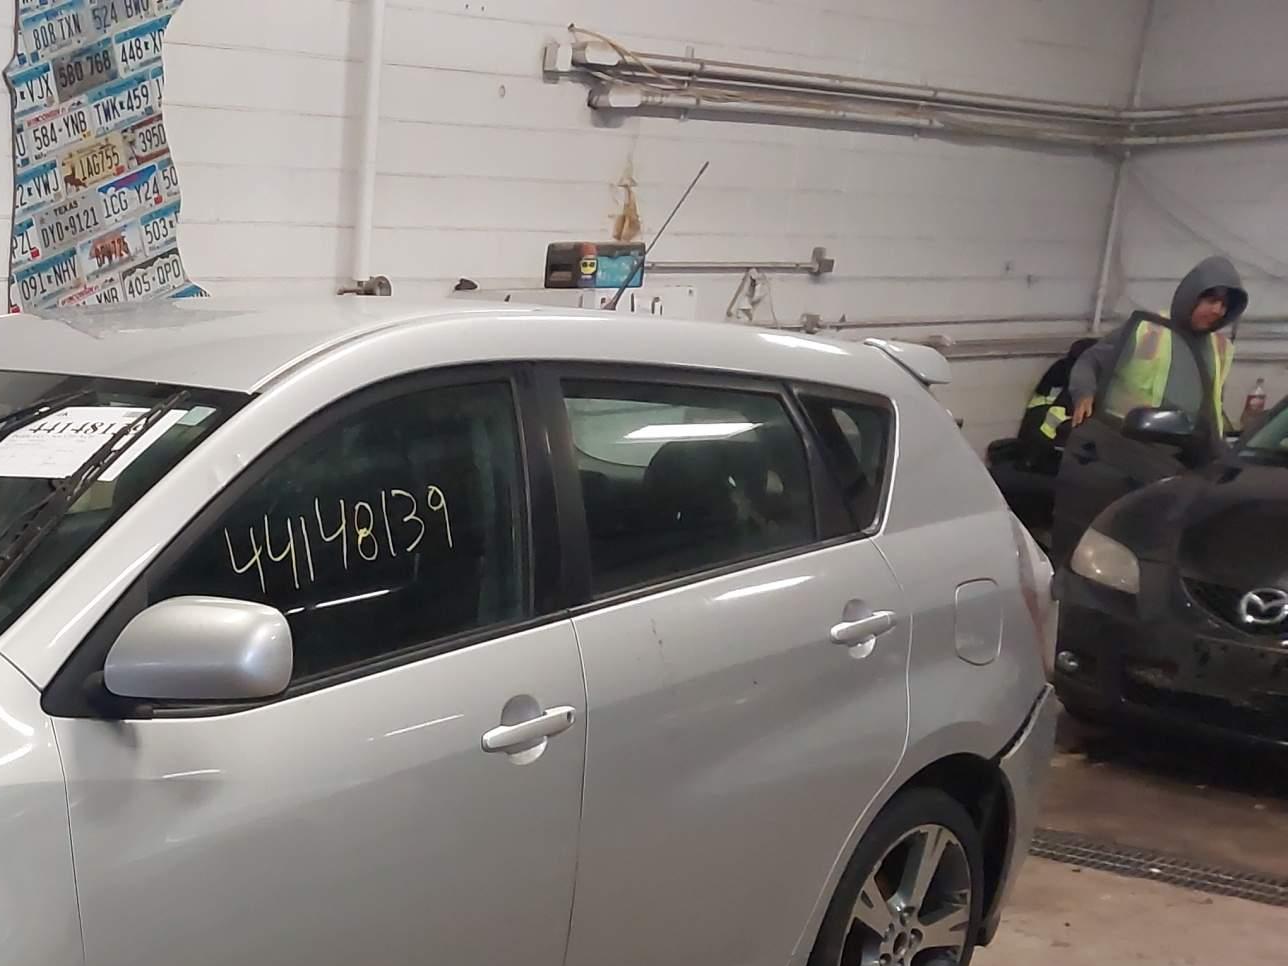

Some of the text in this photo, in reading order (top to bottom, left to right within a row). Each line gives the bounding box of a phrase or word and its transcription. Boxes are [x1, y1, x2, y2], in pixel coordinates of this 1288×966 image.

[33, 23, 57, 50] 808
[53, 200, 78, 216] TEXAS
[224, 485, 453, 594] 44148139
